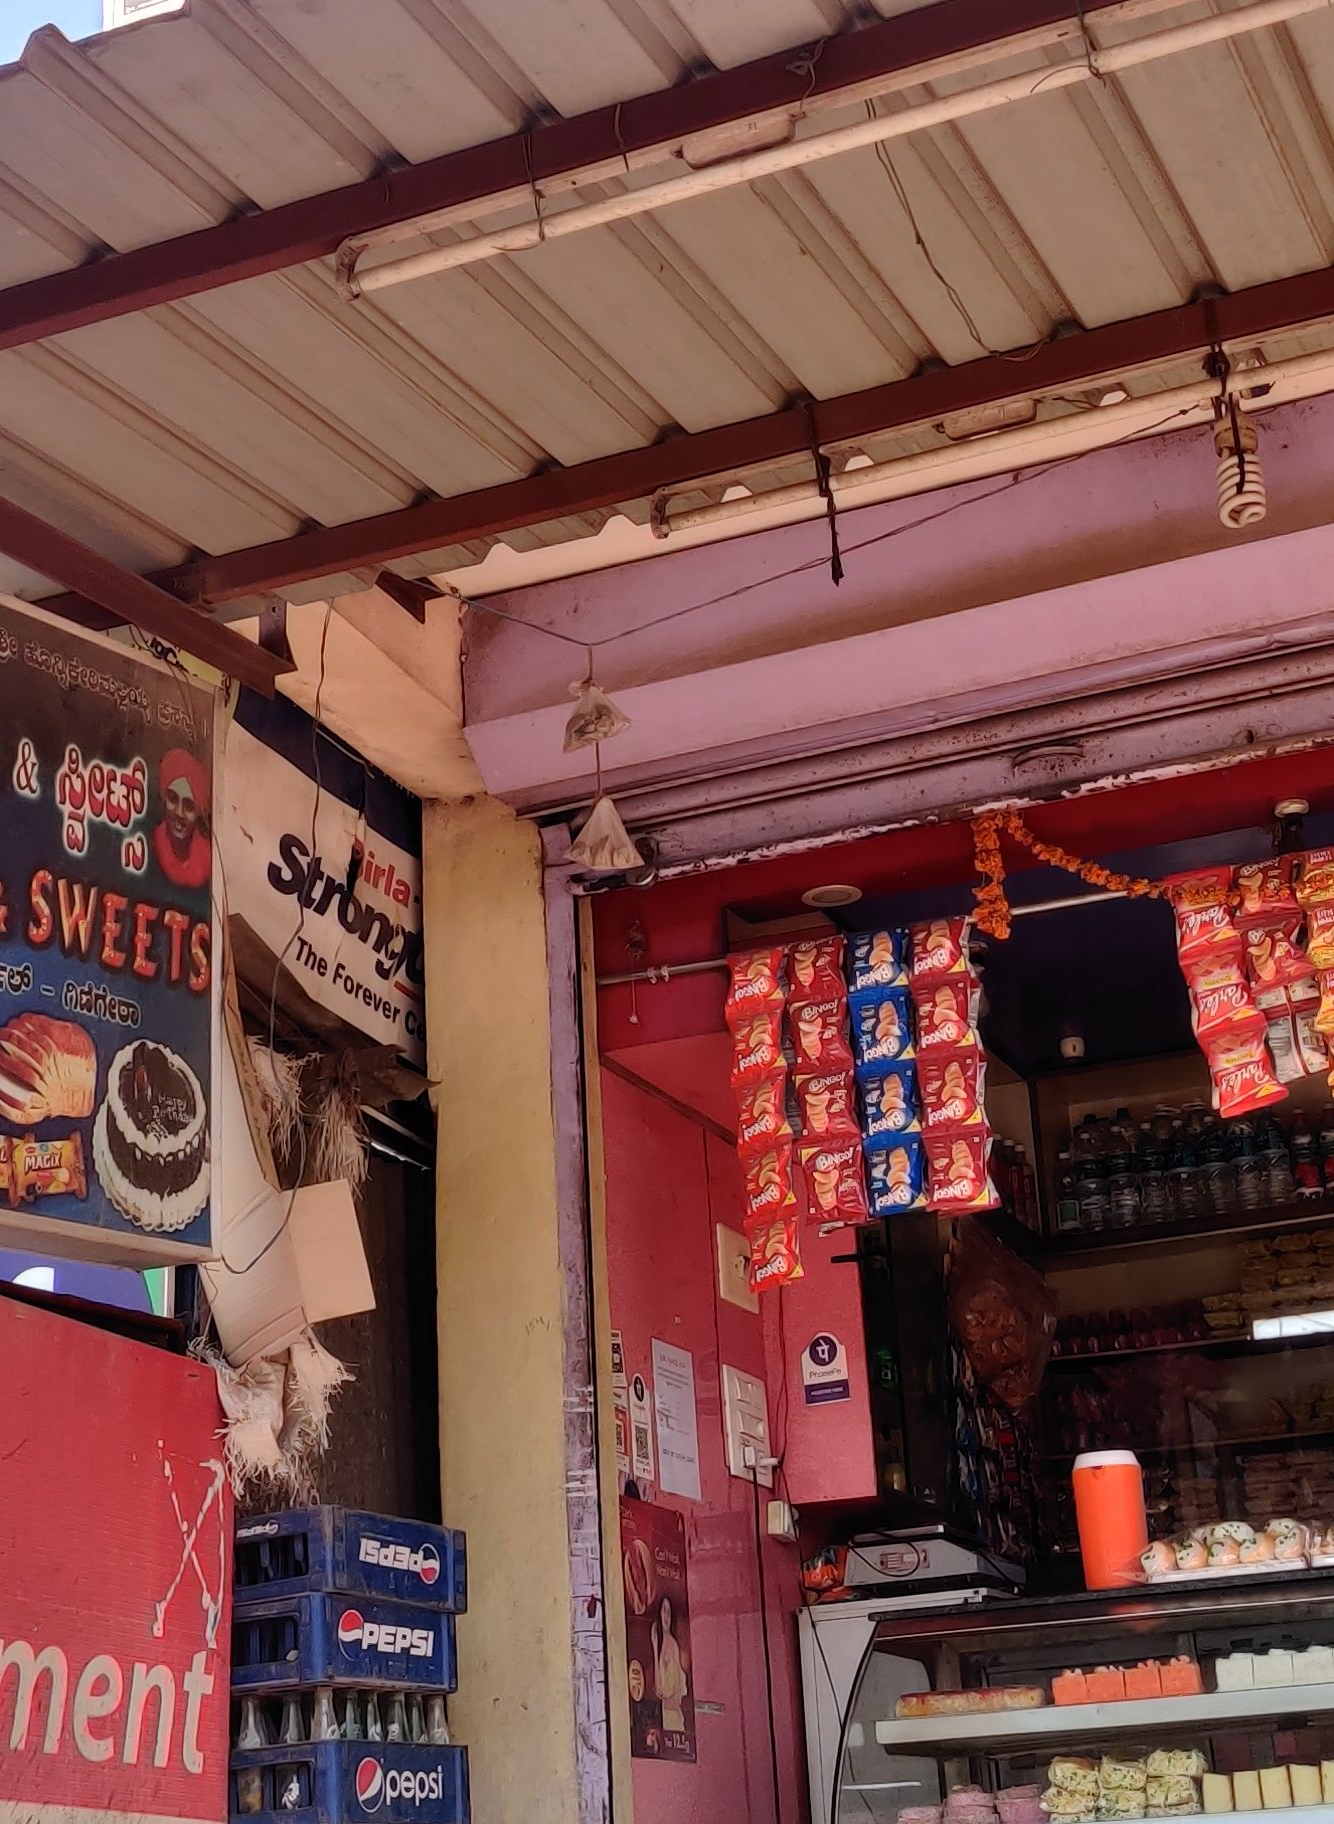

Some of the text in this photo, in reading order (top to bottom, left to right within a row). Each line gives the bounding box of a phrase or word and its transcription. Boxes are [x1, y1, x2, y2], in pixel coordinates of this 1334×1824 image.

[14, 737, 40, 798] &
[28, 869, 211, 992] SWEETS
[295, 935, 329, 978] The
[332, 962, 401, 1024] Forever
[359, 1537, 424, 1573] PEPSI
[362, 1622, 435, 1657] PEPSI
[384, 1764, 444, 1807] pepsi
